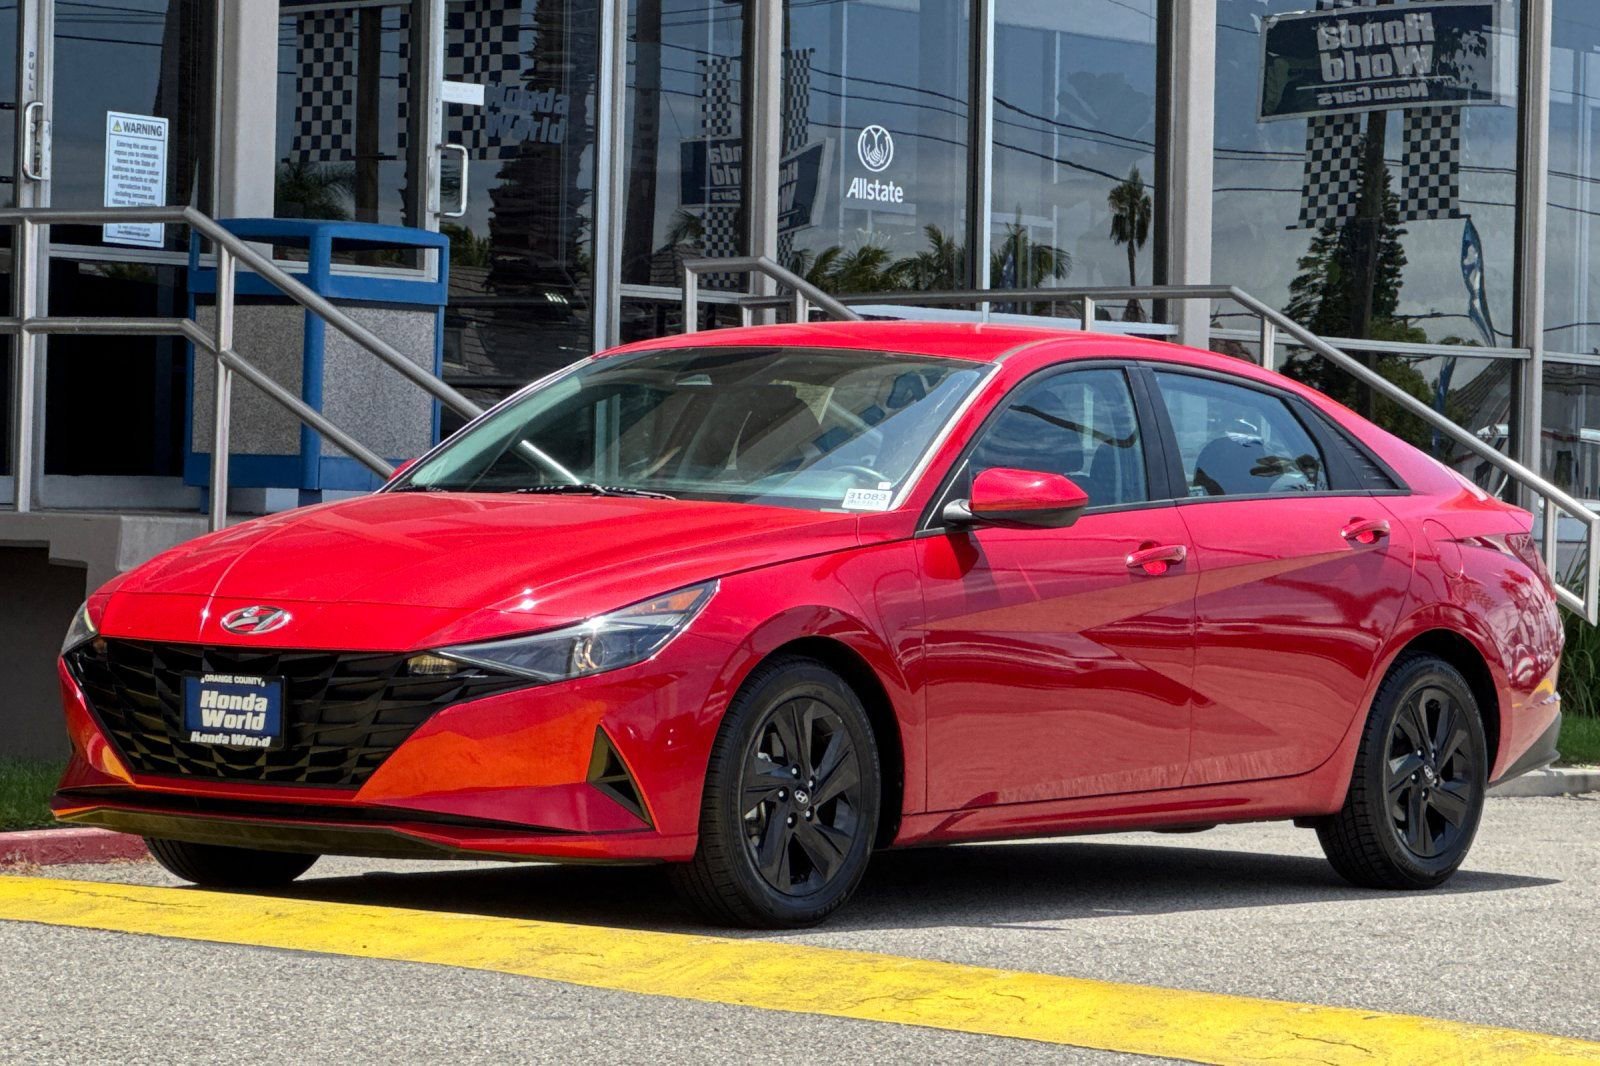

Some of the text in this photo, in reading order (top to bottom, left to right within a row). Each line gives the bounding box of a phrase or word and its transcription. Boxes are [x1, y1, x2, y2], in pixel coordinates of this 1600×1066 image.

[123, 121, 162, 137] WARNING
[486, 113, 568, 143] World
[846, 177, 904, 203] Allstate
[848, 492, 887, 501] 31083
[204, 674, 262, 685] ORANGE COUNTY
[200, 690, 268, 712] Honda
[201, 709, 266, 731] World
[190, 731, 230, 745] Honda
